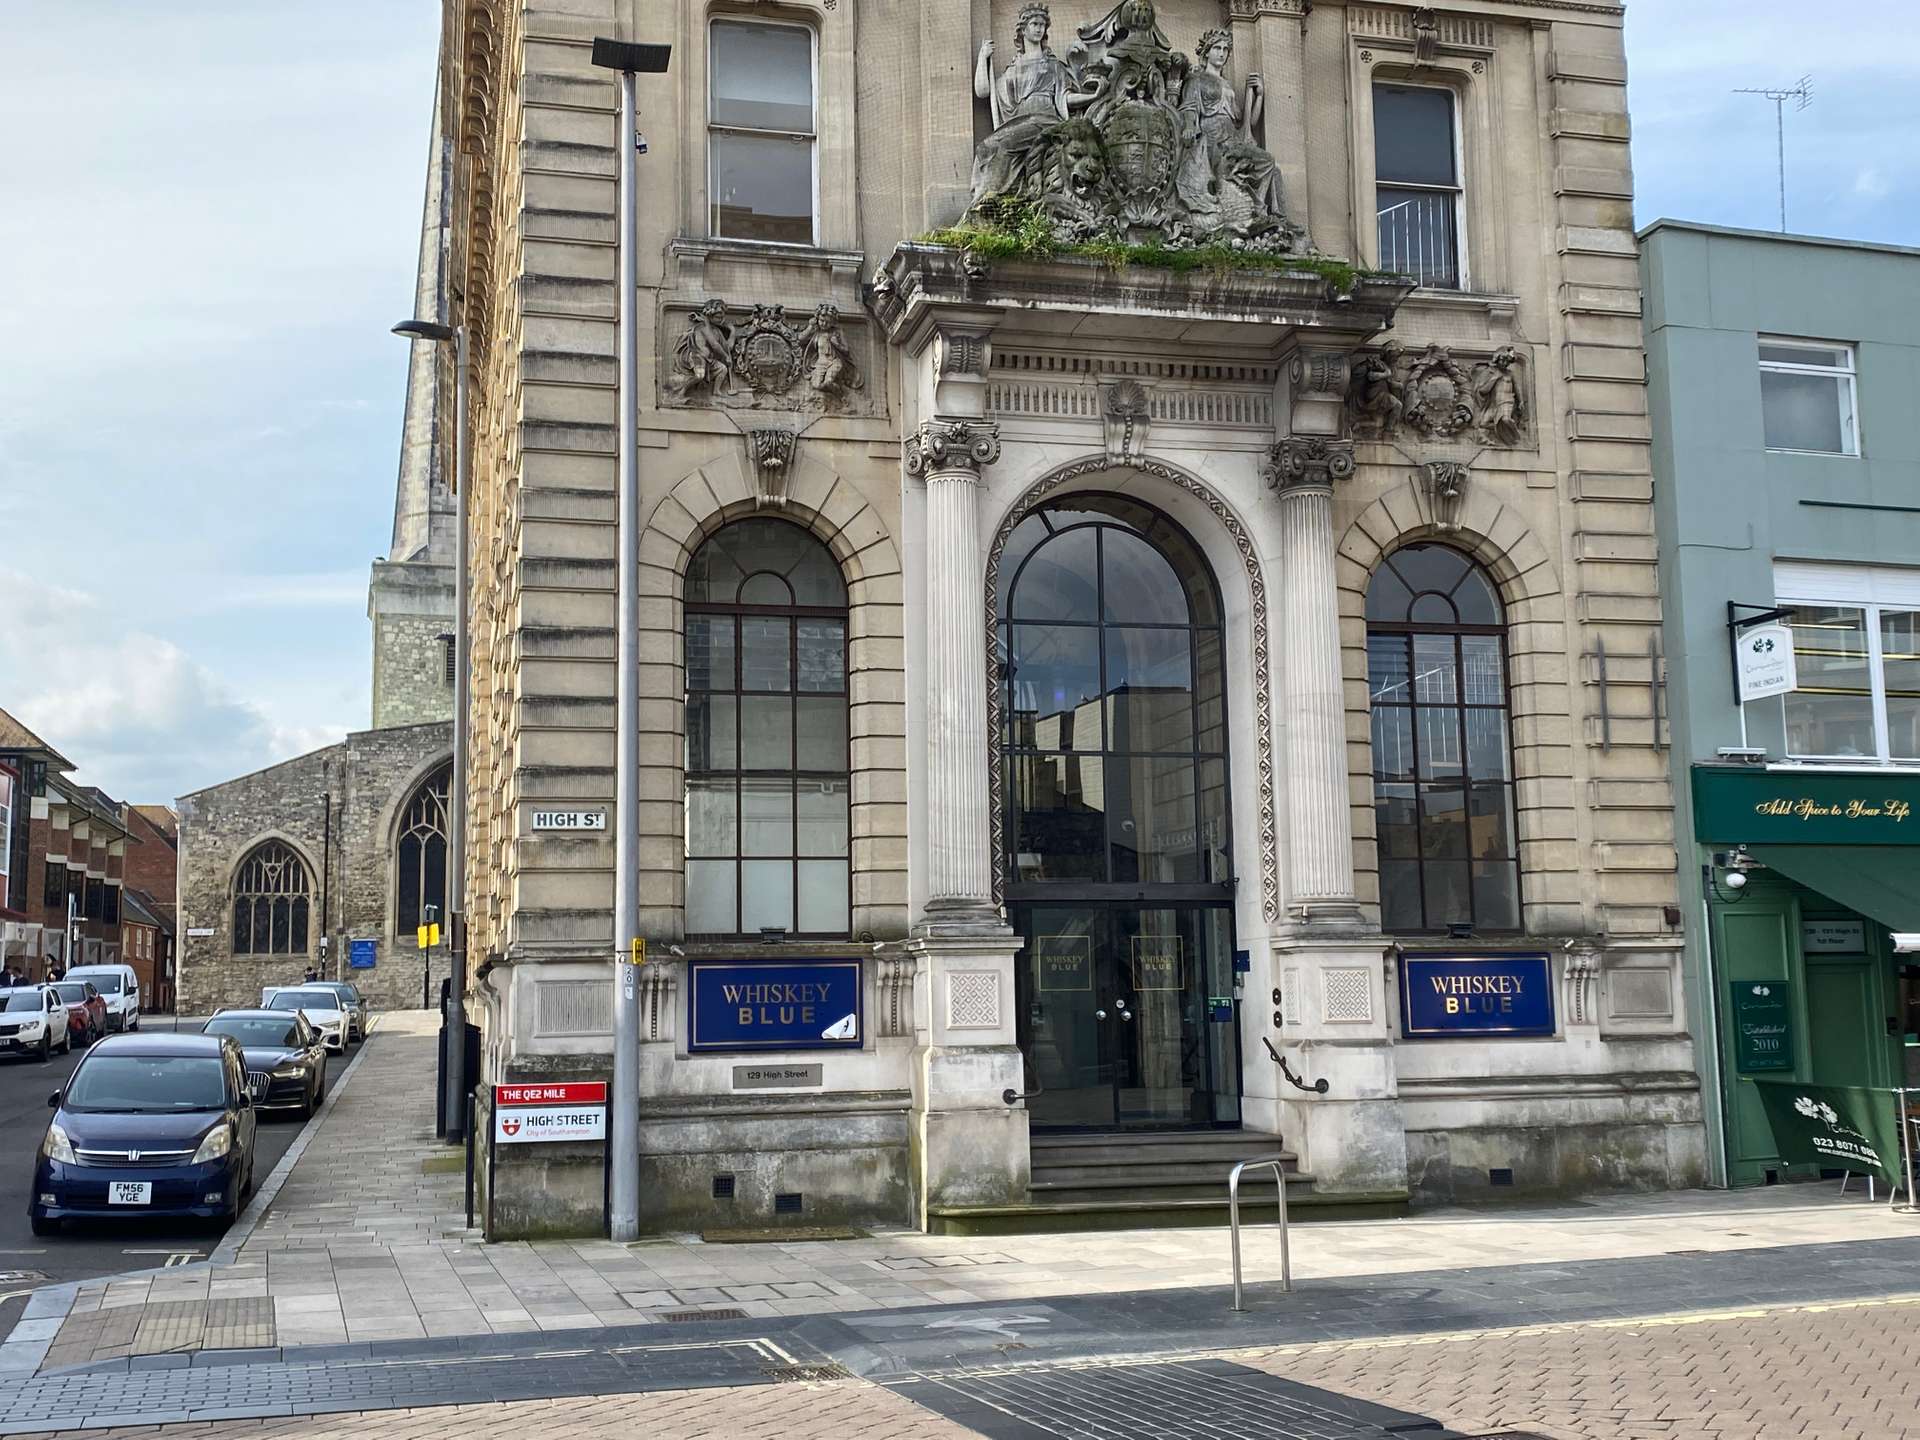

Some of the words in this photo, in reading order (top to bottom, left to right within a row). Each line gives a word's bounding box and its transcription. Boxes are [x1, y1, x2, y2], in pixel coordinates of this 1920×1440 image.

[1756, 799, 1794, 815] Add
[1794, 799, 1829, 821] Spice
[1831, 804, 1842, 816] to
[1845, 800, 1881, 818] Your
[1884, 799, 1910, 823] Life
[537, 813, 577, 827] HIGH
[1046, 955, 1085, 964] WHISKEY
[1139, 955, 1176, 964] WHISKEY
[1051, 963, 1079, 971] BLUE
[1145, 963, 1172, 971] BLUE
[1430, 975, 1525, 994] WHISKEY
[722, 983, 832, 1004] WHISKEY
[1446, 996, 1513, 1014] BLUE
[739, 1006, 816, 1025] BLUE
[1752, 1039, 1779, 1051] 2010
[747, 1071, 761, 1080] 129
[763, 1071, 782, 1081] High
[784, 1070, 809, 1079] Street
[502, 1090, 521, 1100] THE
[523, 1089, 541, 1101] QE2
[543, 1089, 566, 1099] MILE
[526, 1115, 554, 1127] HIGH
[557, 1114, 600, 1126] STREET
[526, 1129, 539, 1137] City
[540, 1128, 547, 1136] of
[547, 1127, 591, 1137] Southampton
[1813, 1137, 1835, 1148] 023
[1835, 1140, 1859, 1153] 8071
[116, 1183, 144, 1193] FM56
